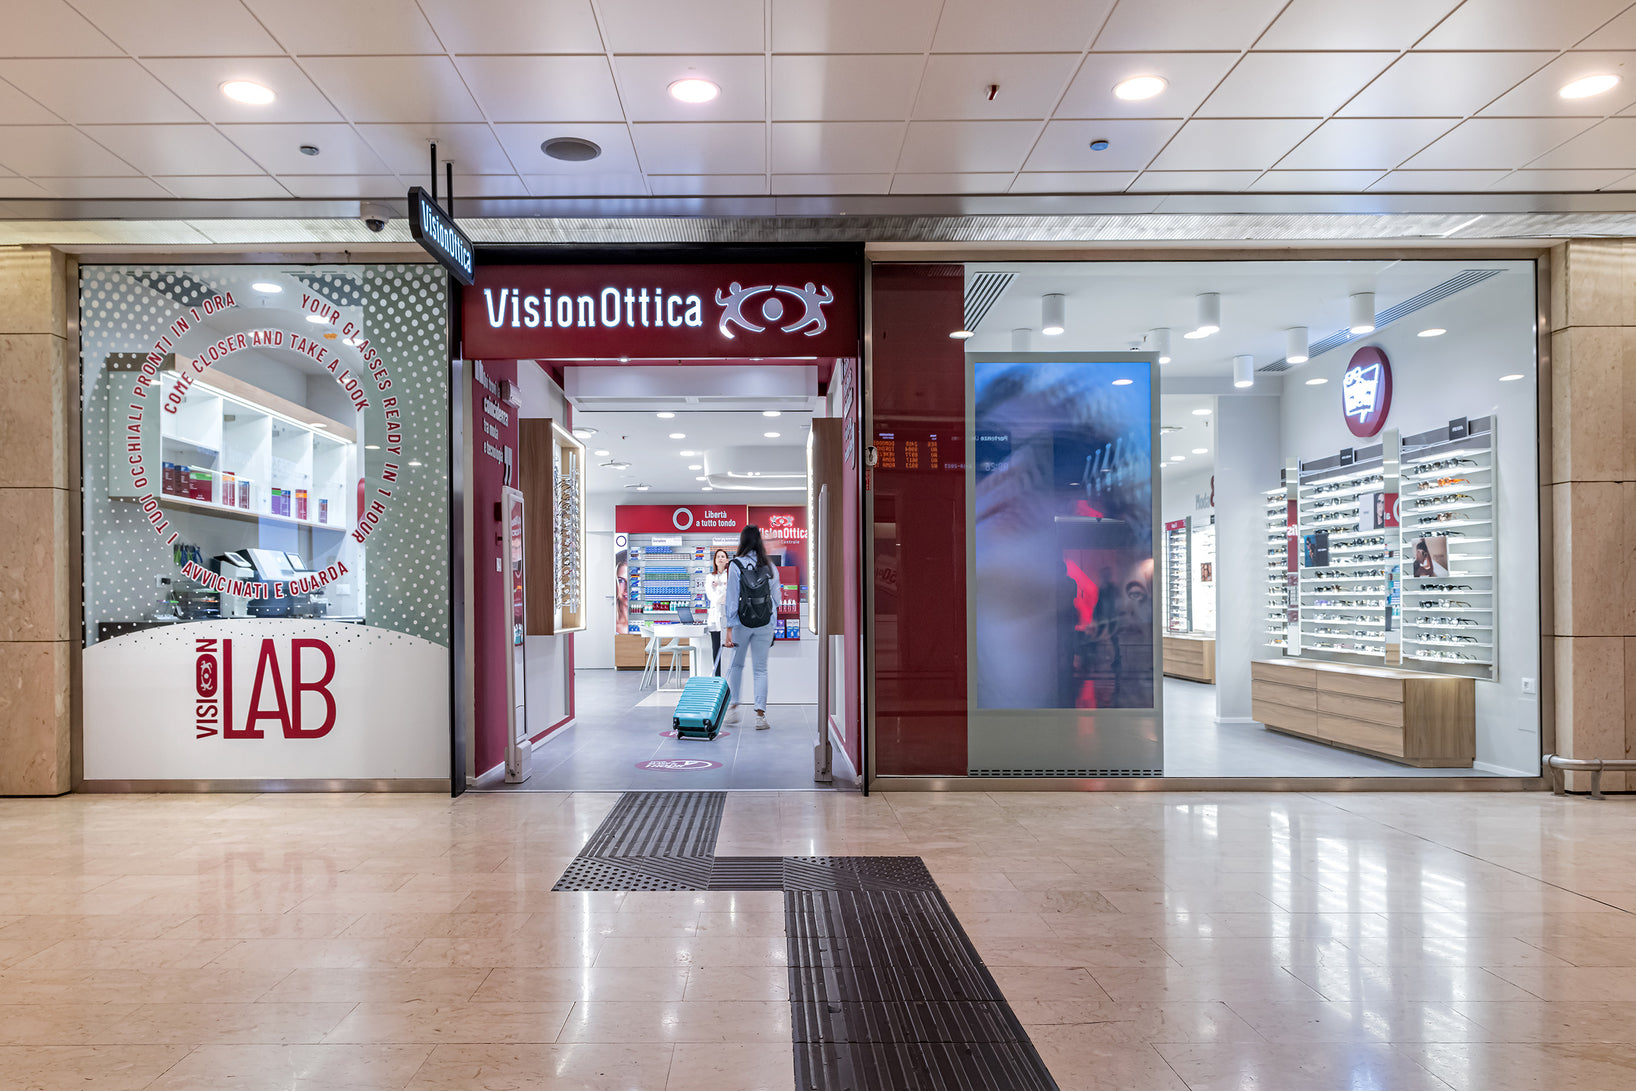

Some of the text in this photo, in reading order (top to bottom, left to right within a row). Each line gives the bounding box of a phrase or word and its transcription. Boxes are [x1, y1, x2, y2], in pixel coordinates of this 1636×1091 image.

[421, 199, 472, 274] VisionOttica
[483, 287, 703, 328] VisionOttica
[164, 330, 369, 415] COME CLOSER AND TAKE A LOOK
[127, 292, 235, 545] I TUOI OCCHIALI PRONTI IN 1 ORA
[302, 293, 401, 544] YOUR GLASSES READY IN 1 HOUR
[701, 519, 717, 527] tutto
[718, 519, 736, 527] tondo
[704, 510, 728, 519] Libertà
[182, 561, 349, 599] AVVICINATI E GUARDA
[196, 639, 217, 740] VISION
[223, 639, 337, 739] LAB
